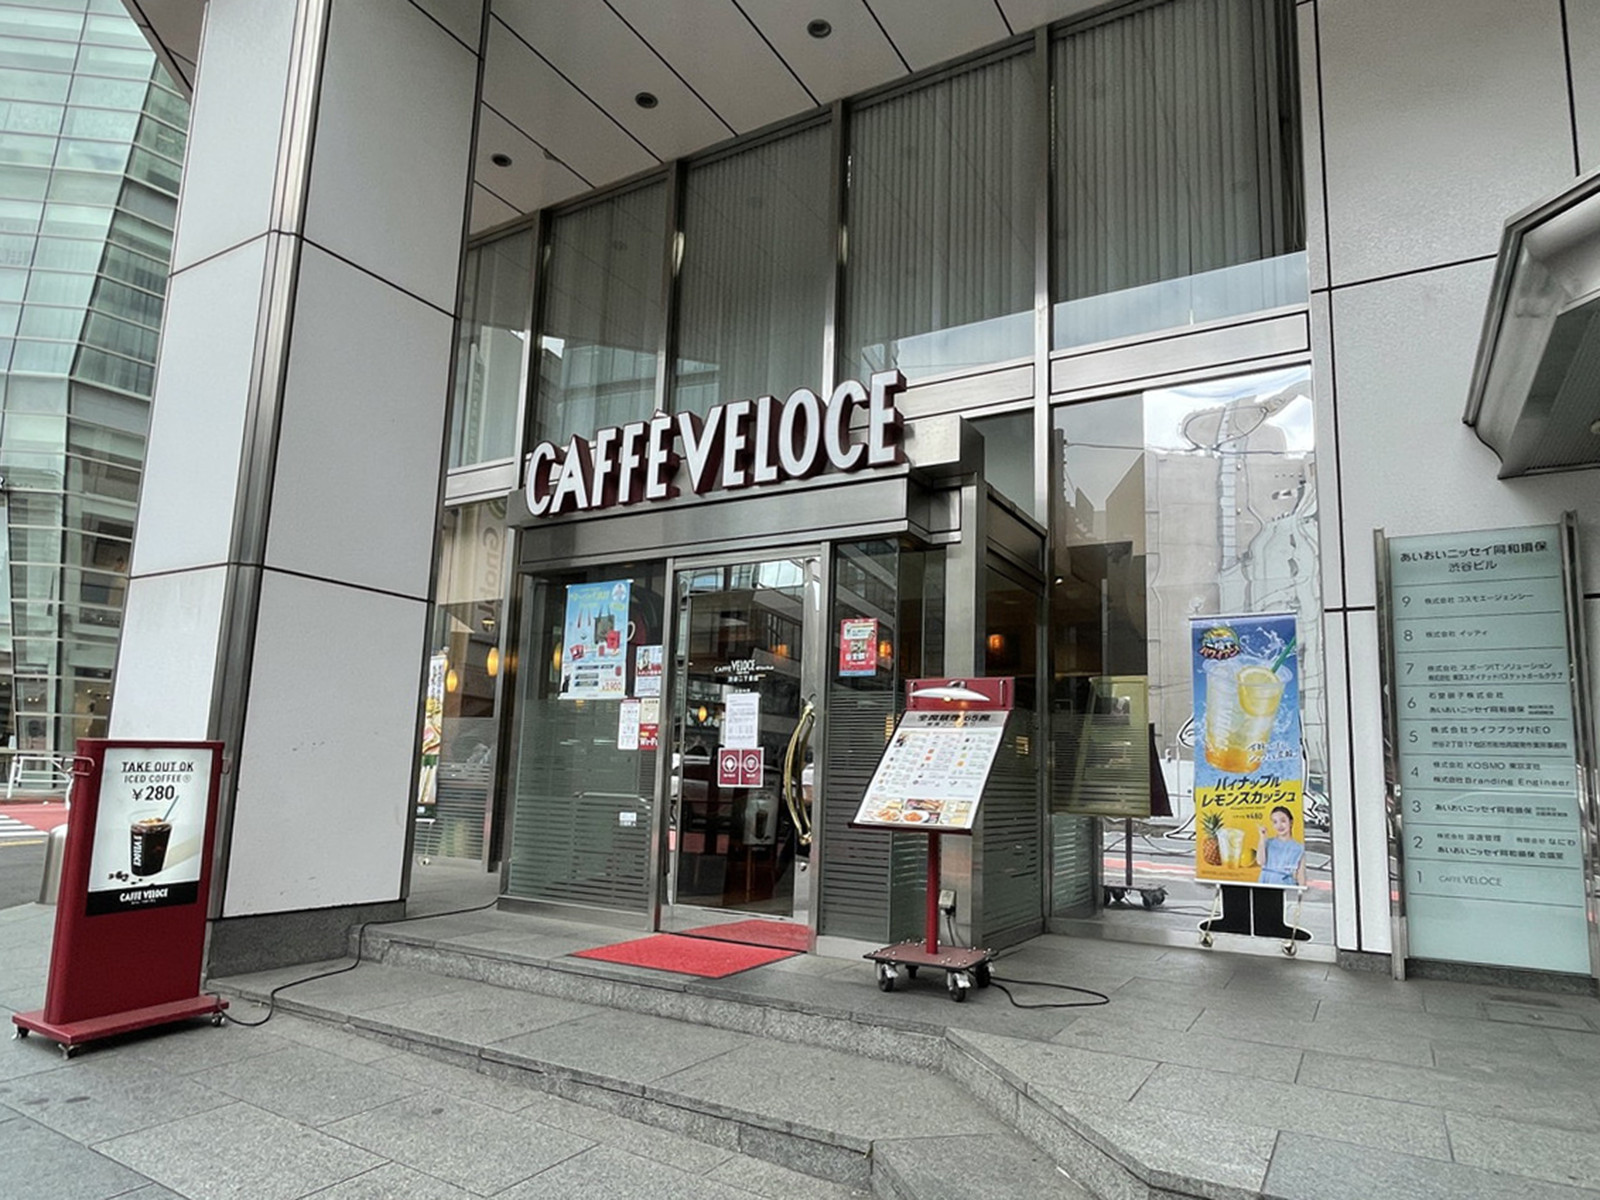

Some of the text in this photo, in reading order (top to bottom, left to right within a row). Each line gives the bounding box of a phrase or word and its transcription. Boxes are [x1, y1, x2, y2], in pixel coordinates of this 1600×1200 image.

[678, 368, 904, 494] VELOCE
[1400, 541, 1548, 562] あいおいニッセイ同和損保
[1448, 560, 1498, 573] 渋谷ビル
[1402, 596, 1411, 608] 9
[1424, 596, 1455, 605] 株式会社
[1403, 630, 1413, 642] 8
[1425, 630, 1456, 639] 株式会社
[731, 659, 756, 673] VELOCE
[1405, 663, 1415, 675] 7
[1427, 664, 1458, 673] 株式会社
[1407, 697, 1417, 709] 6
[1409, 730, 1419, 743] 5
[121, 761, 195, 773] TAKE OUT OK
[1410, 767, 1419, 777] 4
[1432, 761, 1464, 770] 株式会社
[1466, 762, 1506, 771] KOSMO
[124, 775, 146, 784] ICED
[150, 774, 181, 784] COFFEE
[1214, 774, 1282, 792] パイナップル
[1517, 778, 1570, 788] Engineer
[132, 785, 175, 801] ¥280
[1202, 790, 1297, 808] レモンスカッシュ
[1412, 800, 1422, 813] 3
[1413, 836, 1423, 849] 2
[1416, 871, 1423, 883] 1
[1463, 876, 1503, 887] VELOCE
